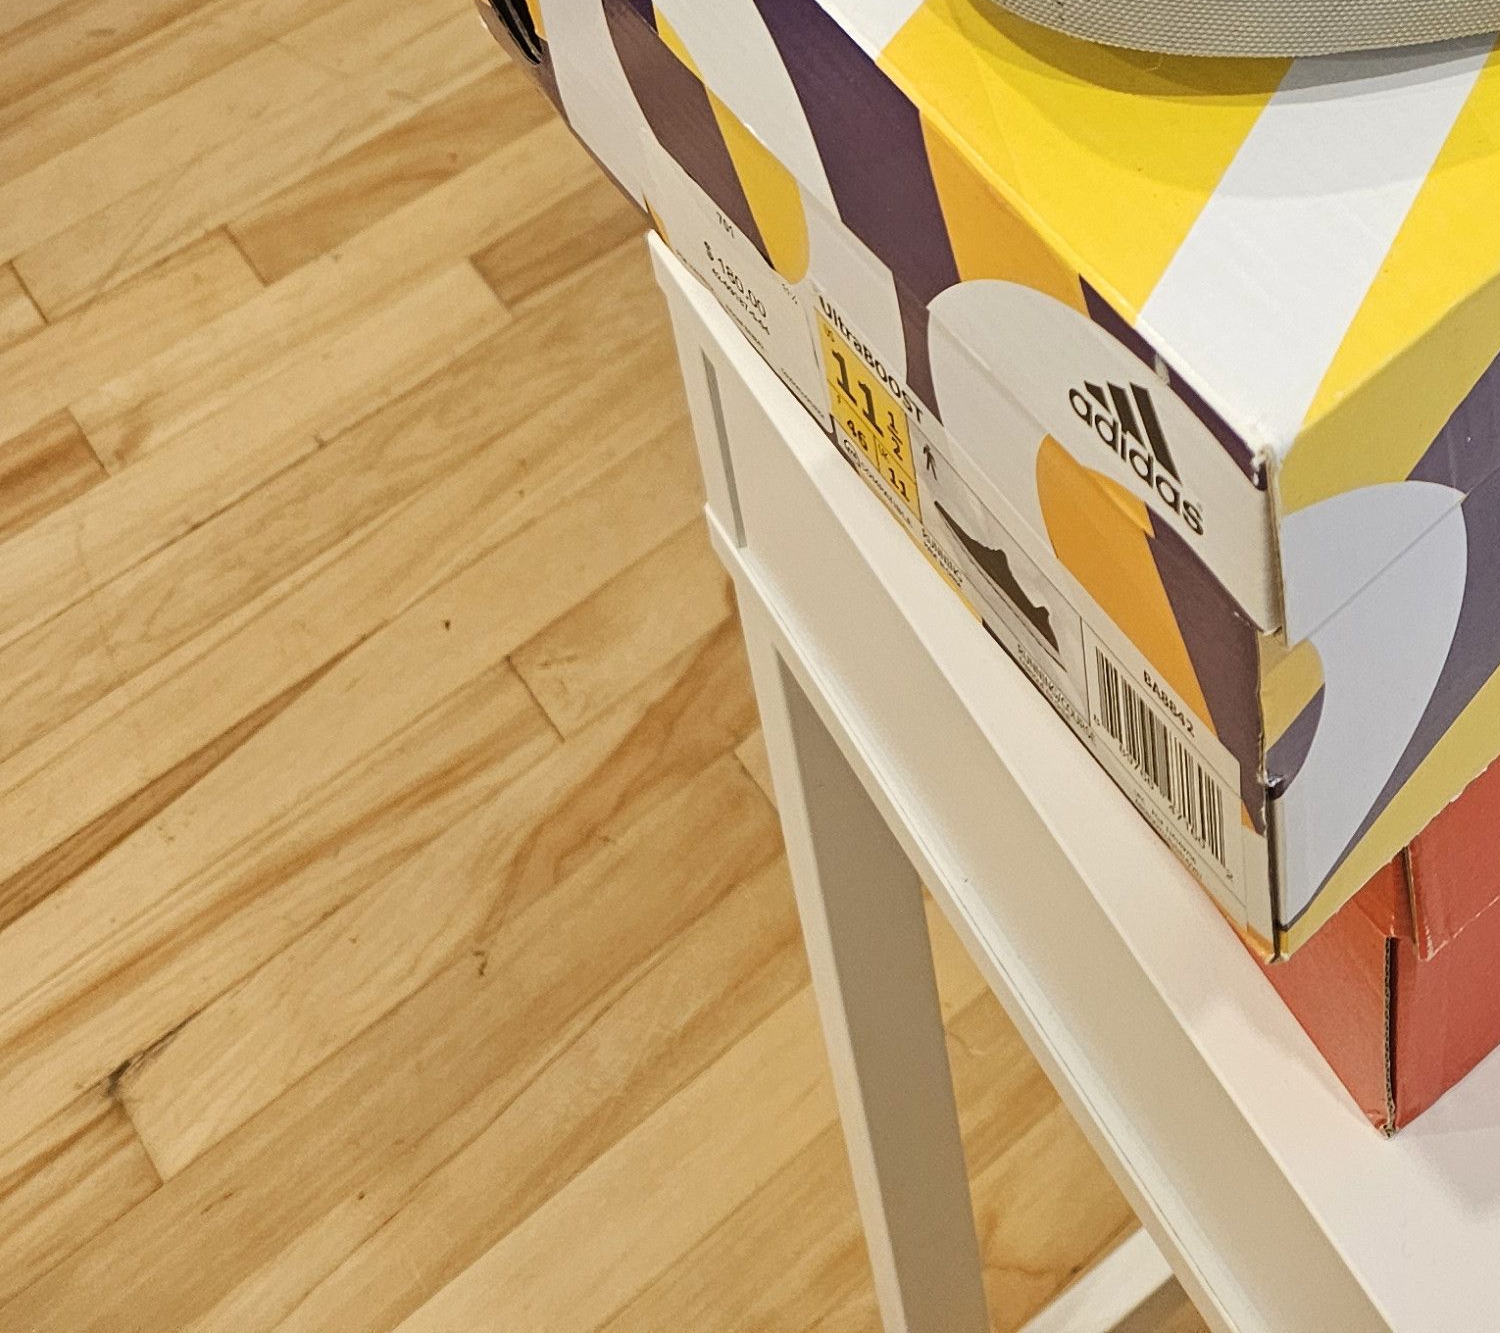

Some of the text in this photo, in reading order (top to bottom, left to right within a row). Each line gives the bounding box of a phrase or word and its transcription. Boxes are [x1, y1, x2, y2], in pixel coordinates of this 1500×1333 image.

[818, 295, 924, 424] UltraBOOST
[831, 348, 885, 439] 11
[846, 419, 868, 452] 46
[1068, 387, 1204, 536] adidas
[888, 466, 911, 503] 11
[1143, 668, 1196, 739] BA8842
